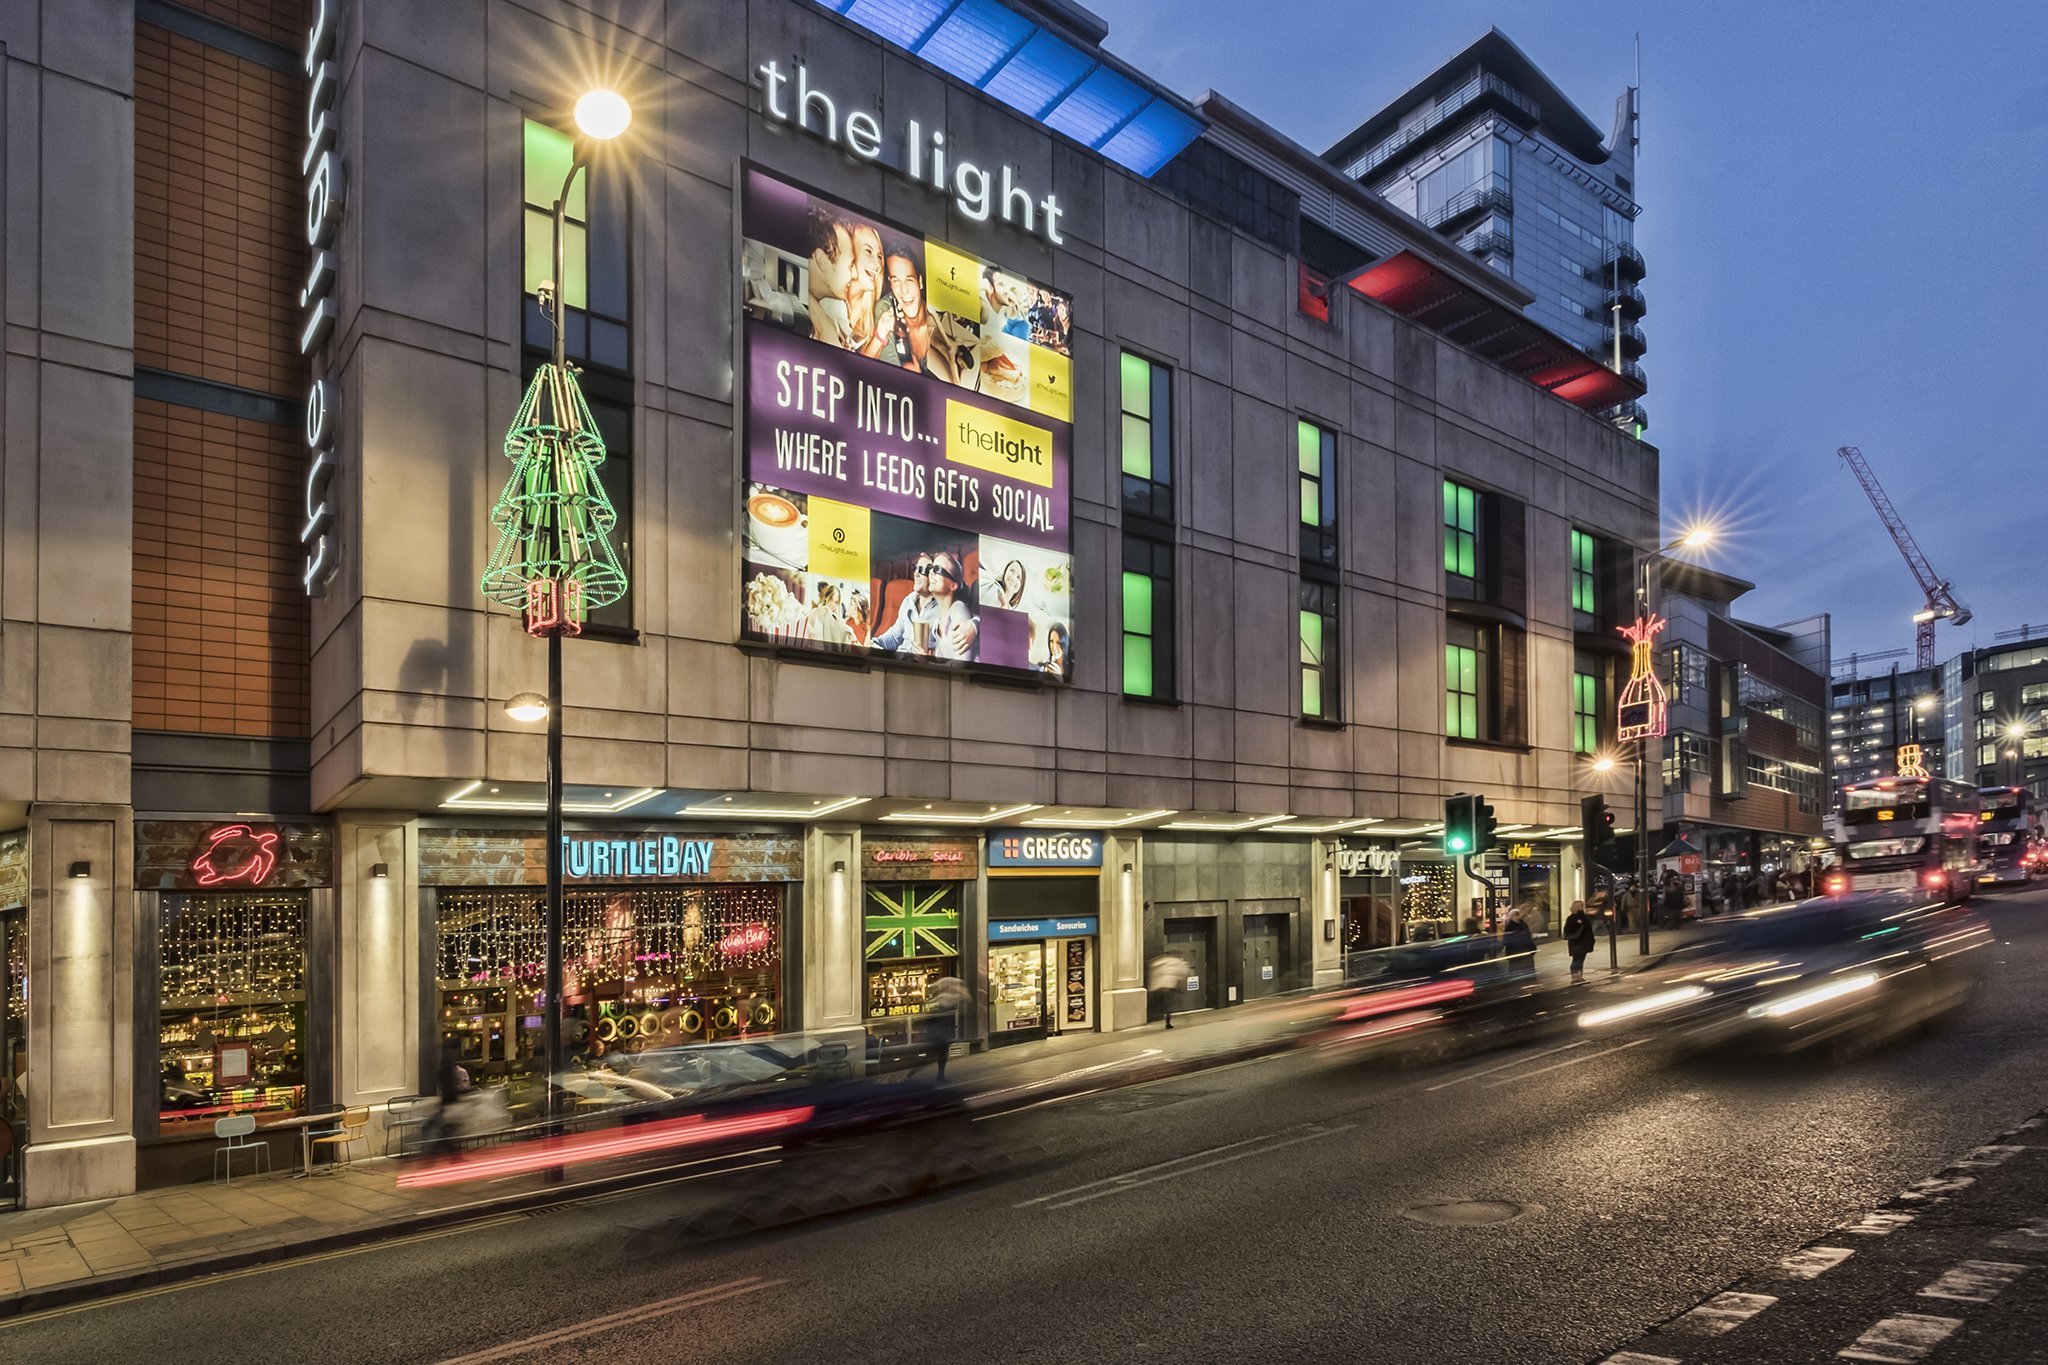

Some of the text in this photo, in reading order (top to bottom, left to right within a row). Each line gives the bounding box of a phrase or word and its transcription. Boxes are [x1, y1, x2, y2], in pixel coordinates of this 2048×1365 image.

[759, 60, 1064, 246] the light
[300, 0, 329, 597] the light
[776, 360, 939, 445] STEP INTO...
[958, 422, 1042, 466] thelight
[775, 428, 1055, 532] WHERE LEEDS GETS SOCIAL
[932, 851, 964, 862] Social
[1022, 837, 1093, 860] GREGGS
[999, 921, 1087, 933] Sandwiches Savouries
